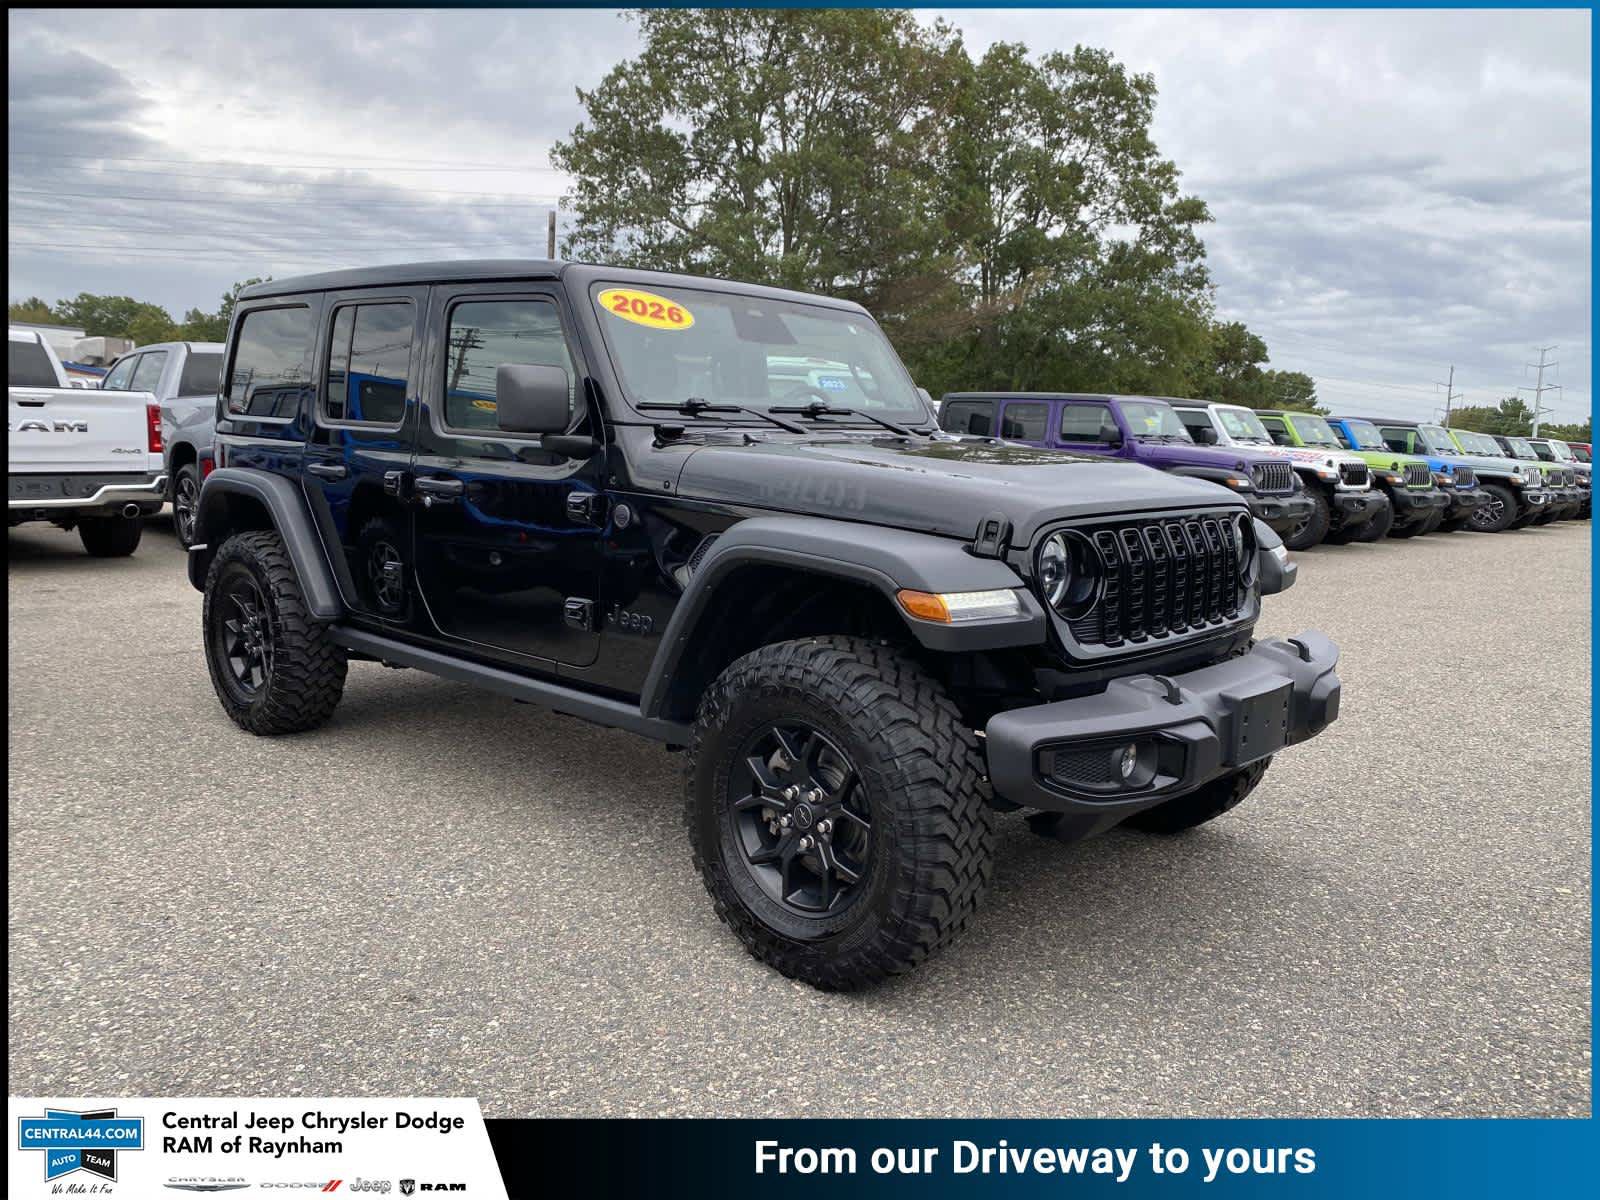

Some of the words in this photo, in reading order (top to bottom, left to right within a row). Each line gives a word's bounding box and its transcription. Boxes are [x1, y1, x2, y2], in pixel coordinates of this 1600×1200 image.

[612, 295, 684, 324] 2026
[8, 420, 88, 433] AM
[607, 604, 653, 634] Jeep
